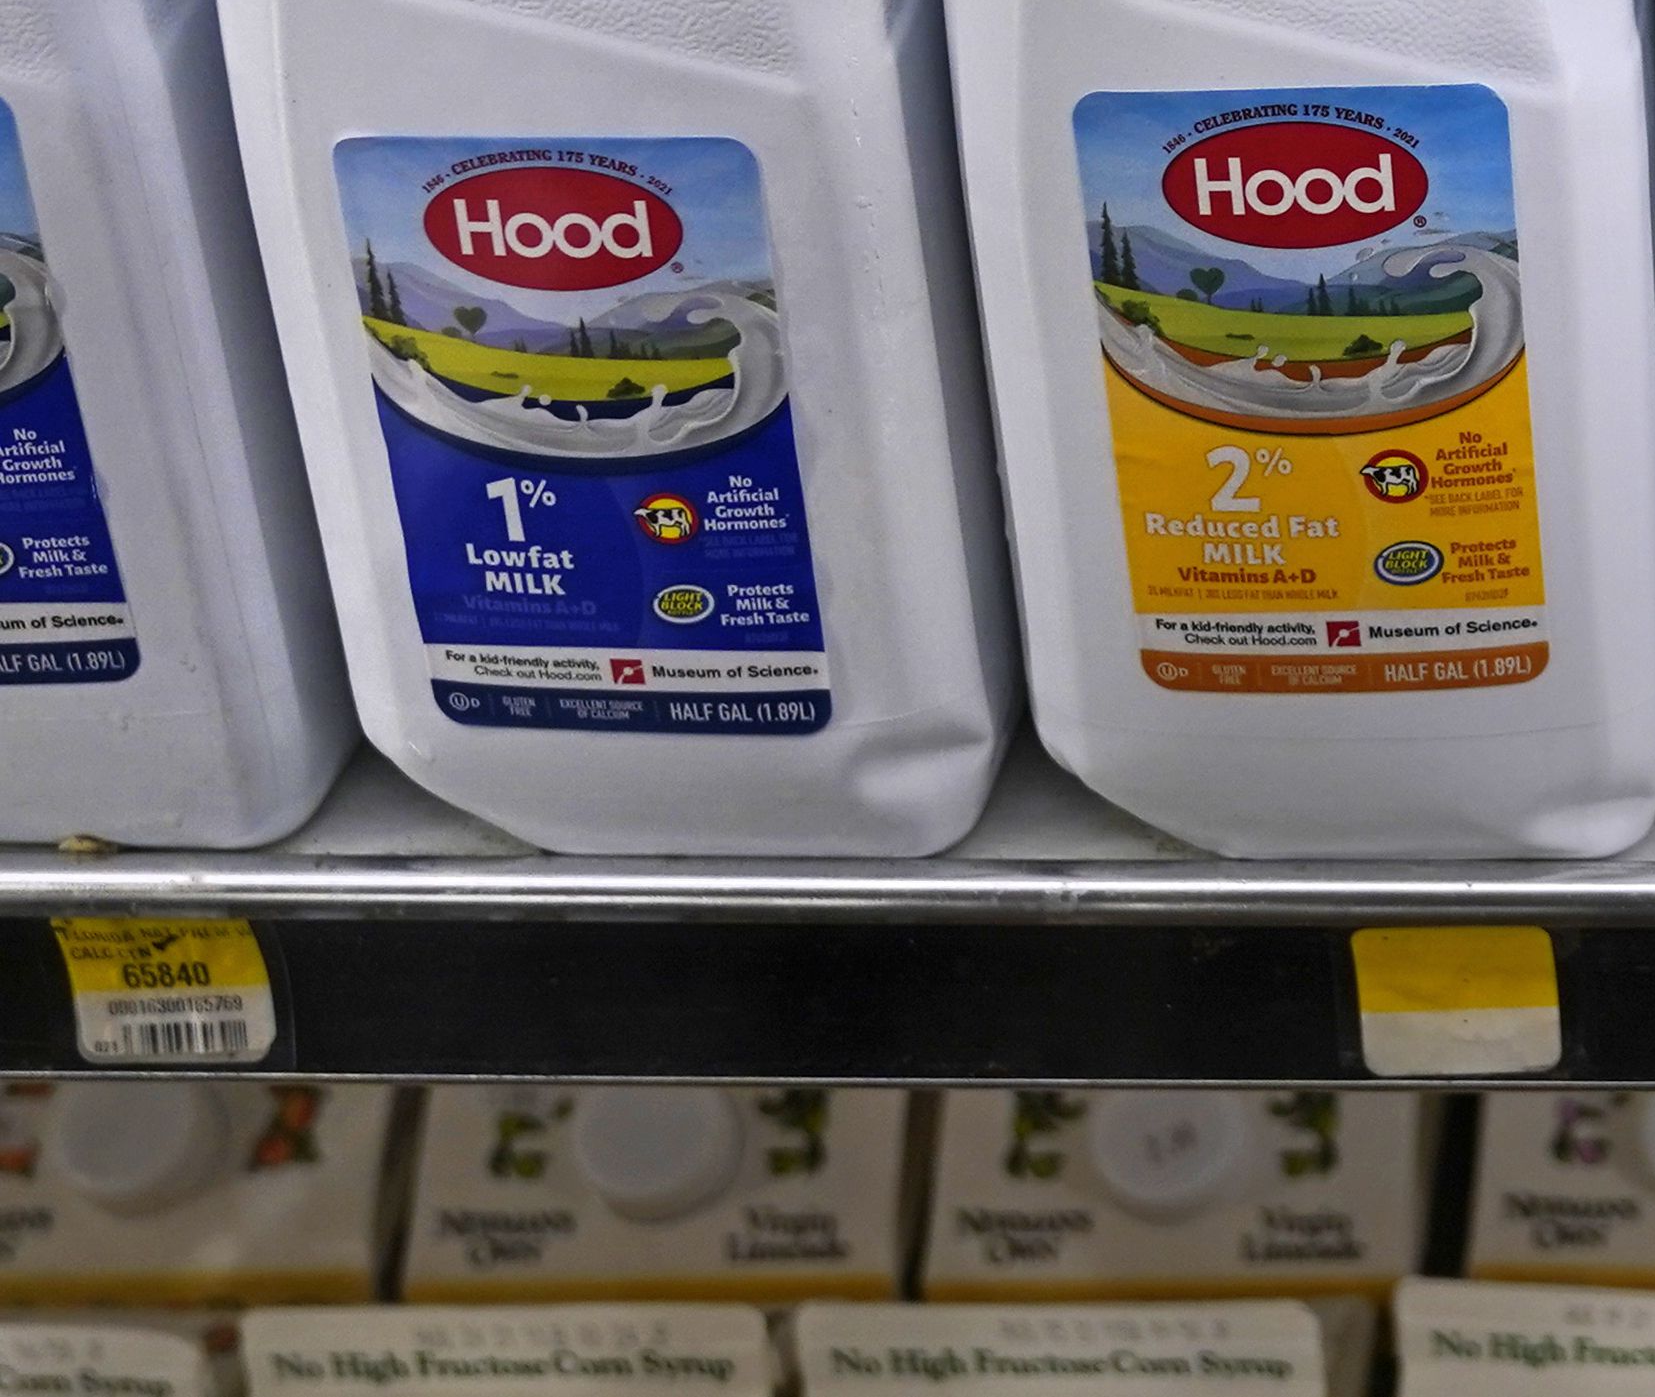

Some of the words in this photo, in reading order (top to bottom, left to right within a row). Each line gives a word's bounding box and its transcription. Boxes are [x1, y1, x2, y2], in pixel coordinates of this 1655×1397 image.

[1194, 104, 1298, 133] CELEBRATING
[1302, 104, 1329, 117] 175
[1335, 108, 1383, 129] YEARS
[452, 149, 552, 175] CELEBRATING
[556, 150, 583, 163] 175
[588, 154, 636, 176] YEARS
[1194, 154, 1396, 215] Hood
[454, 198, 652, 257] Hood
[727, 477, 753, 489] No
[1205, 444, 1295, 513] 2%
[705, 490, 778, 504] Artificial
[485, 477, 557, 544] 1%
[714, 506, 774, 518] Growth
[1144, 512, 1282, 539] Reduced
[1288, 515, 1341, 538] Fat
[23, 534, 89, 549] Protects
[1203, 542, 1287, 565] MILK
[33, 549, 71, 563] Milk
[71, 548, 87, 559] &
[464, 542, 576, 571] Lowfat
[20, 565, 63, 578] Fresh
[63, 561, 108, 575] Taste
[1178, 567, 1269, 584] Vitamins
[1273, 568, 1316, 584] A+D
[484, 570, 567, 598] MILK
[651, 665, 720, 677] Museum
[725, 664, 743, 678] of
[1384, 662, 1430, 681] HALF
[1434, 661, 1468, 679] GAL
[1473, 655, 1532, 678] (1.89L)
[669, 703, 715, 721] HALF
[717, 703, 752, 721] GAL
[755, 701, 815, 722] (1.89L)
[122, 961, 211, 988] 65840
[271, 1350, 325, 1380] No
[330, 1349, 410, 1385] High
